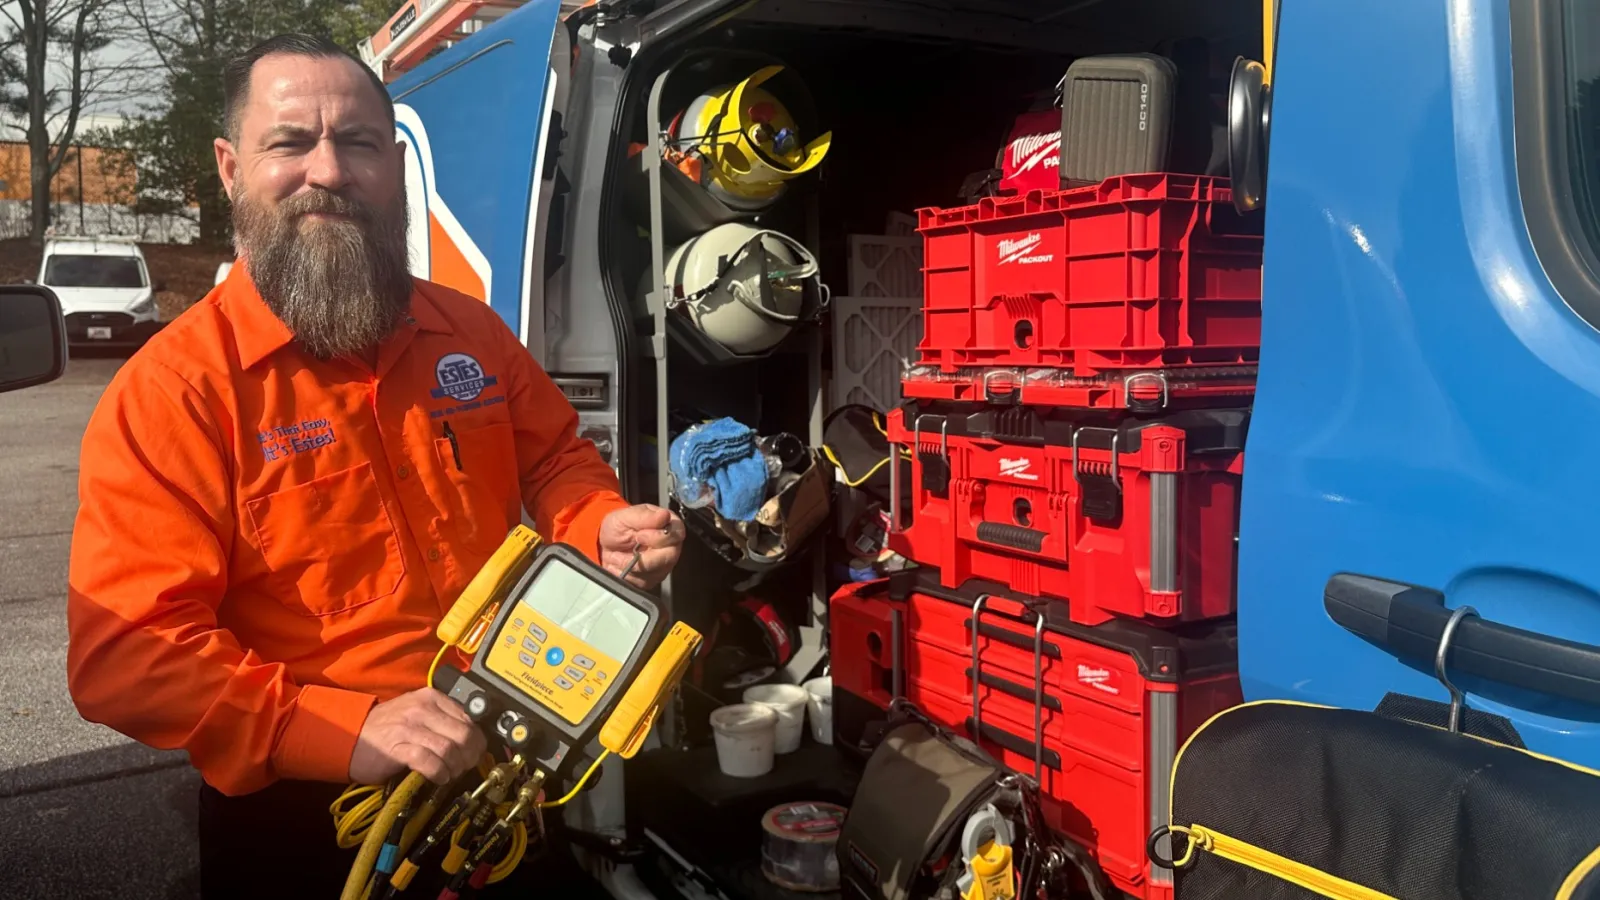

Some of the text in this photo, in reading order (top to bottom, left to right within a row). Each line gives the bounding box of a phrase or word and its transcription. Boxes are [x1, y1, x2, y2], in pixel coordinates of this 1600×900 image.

[996, 232, 1042, 259] Milwaukee
[1018, 254, 1053, 264] PACKOUT
[439, 360, 480, 386] ESTES
[443, 379, 485, 395] SERVICES
[291, 427, 337, 454] Estes!
[520, 670, 555, 696] Fieldpiece
